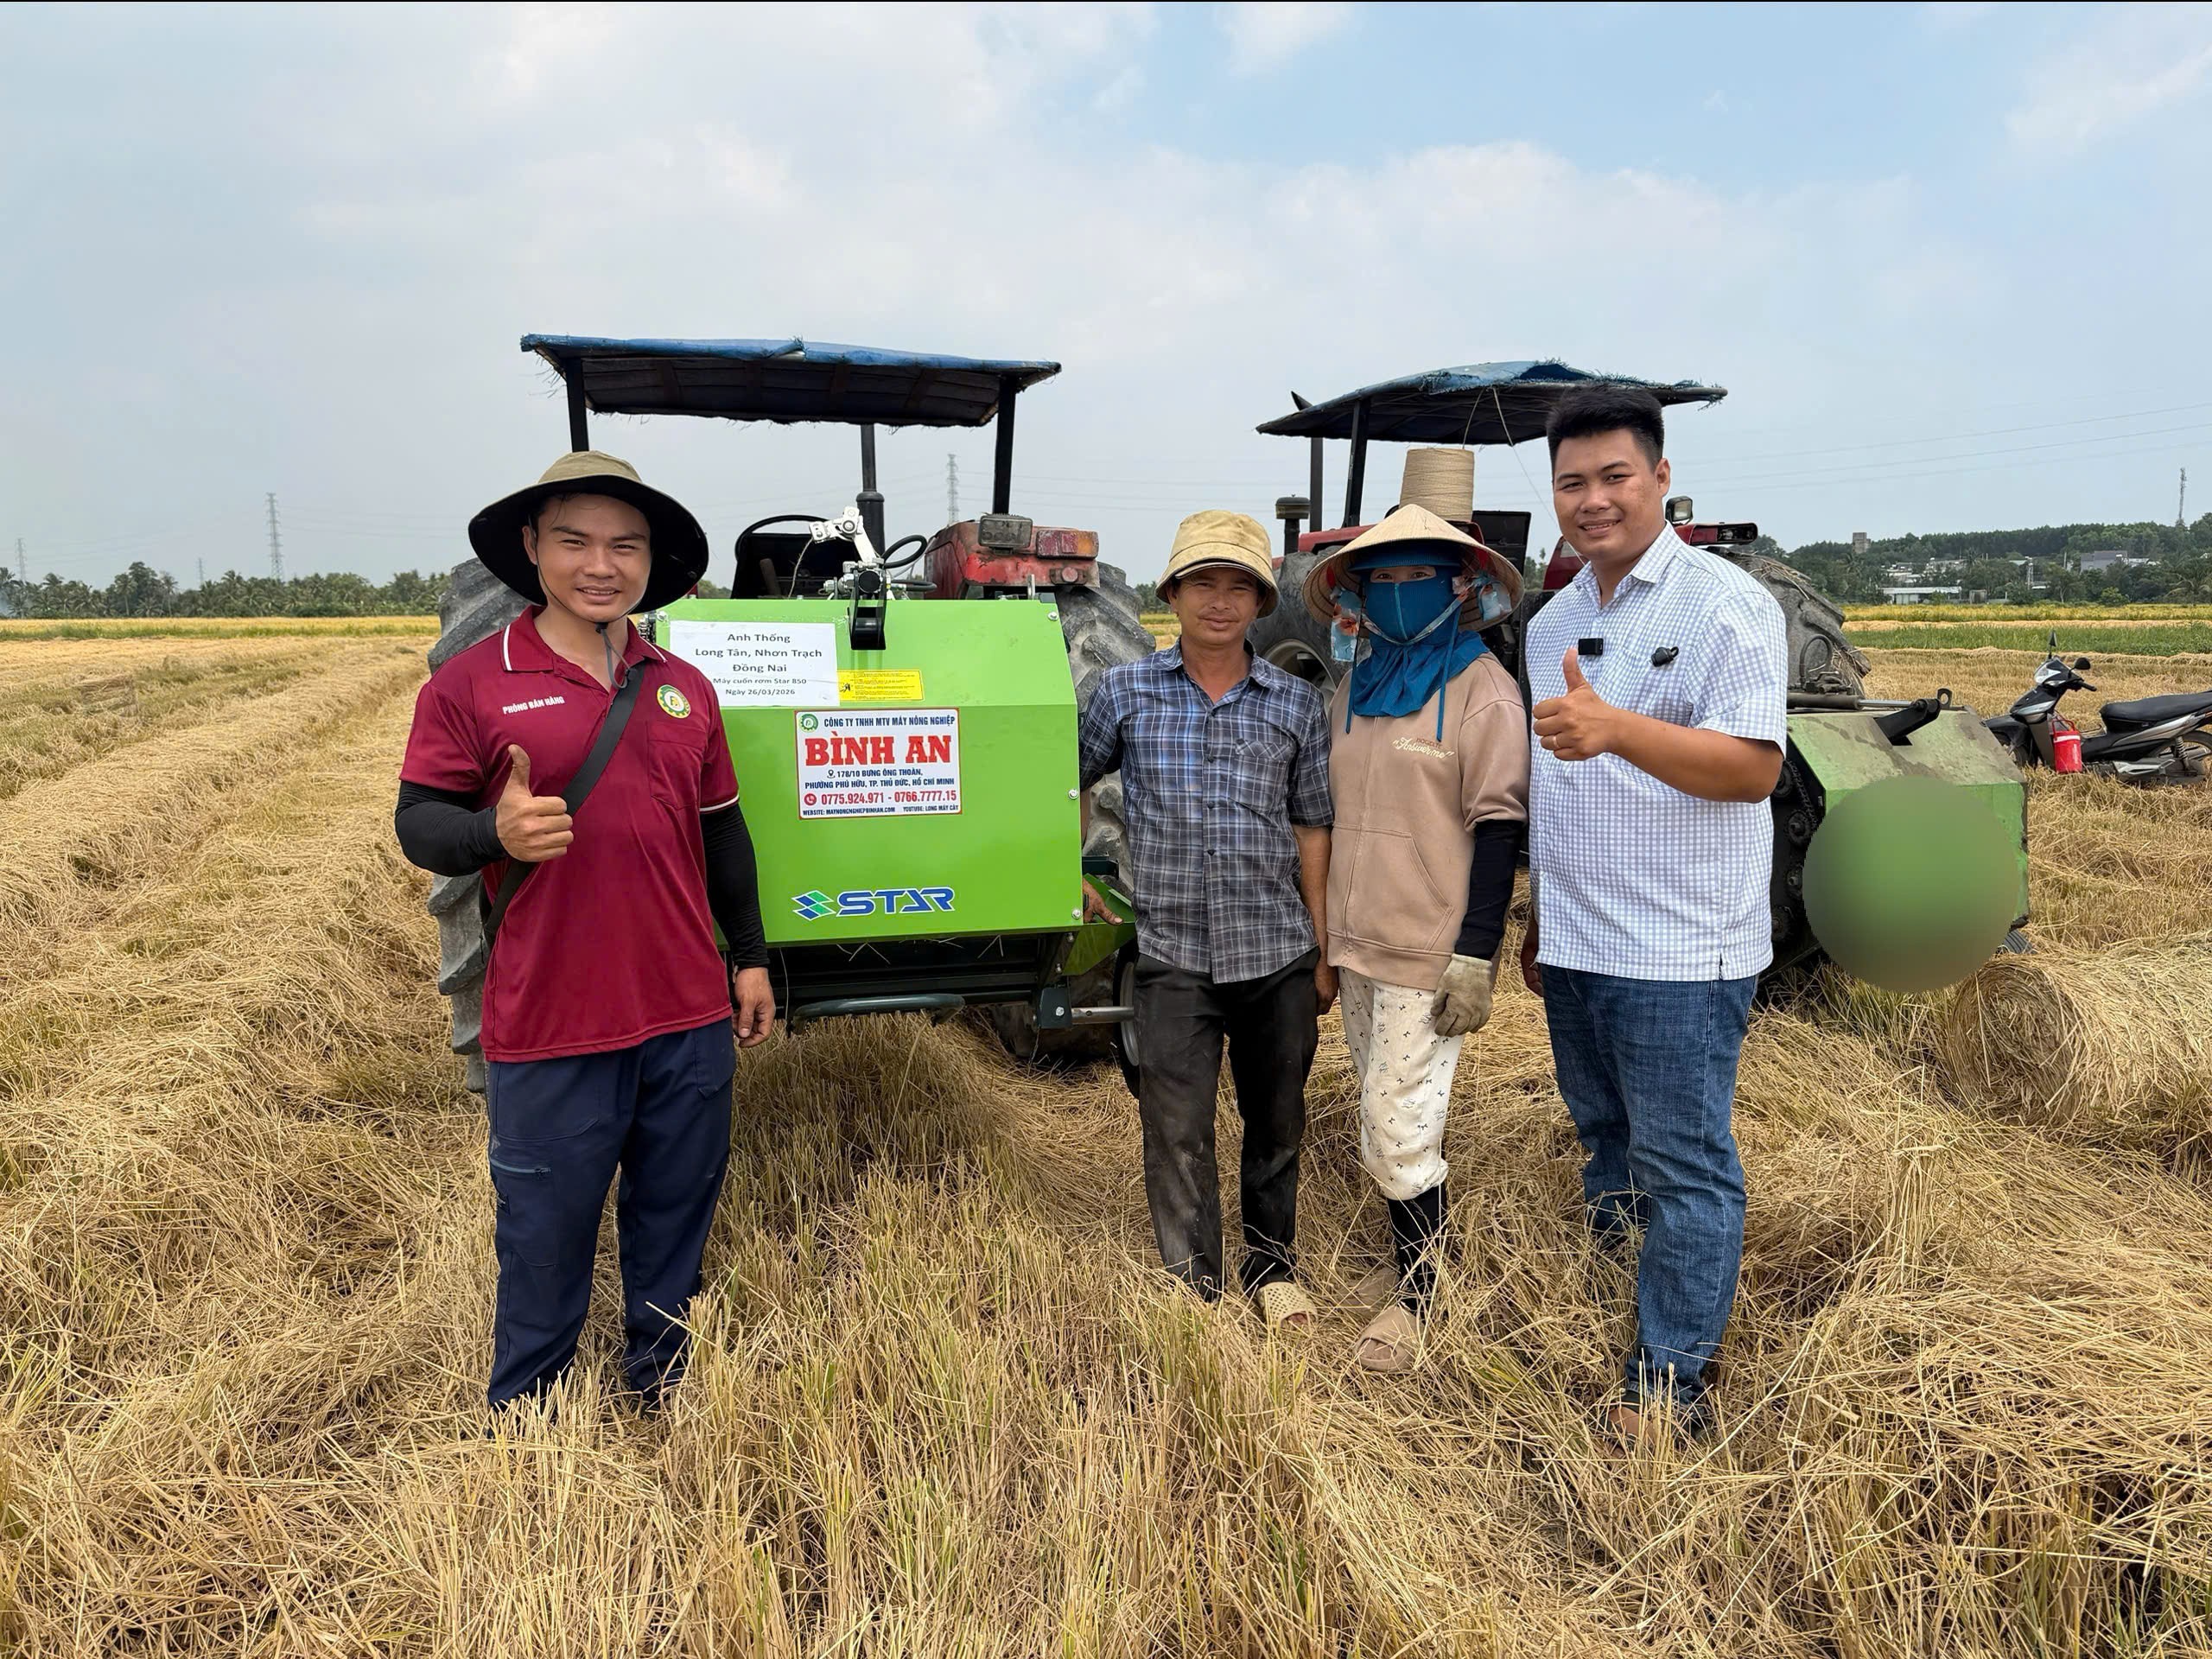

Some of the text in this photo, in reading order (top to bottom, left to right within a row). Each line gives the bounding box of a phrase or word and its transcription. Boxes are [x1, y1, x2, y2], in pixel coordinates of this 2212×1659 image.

[754, 633, 791, 644] Thống
[695, 649, 723, 658] Long
[727, 649, 751, 658] Tân,
[791, 649, 823, 659] Trạch
[733, 664, 787, 673] Đồng Nai
[502, 696, 565, 715] PHÒNG BÁN HÀNG
[823, 716, 843, 728] CÔNG
[845, 718, 854, 727] TY
[855, 717, 874, 727] TNHH
[875, 717, 890, 726] MTV
[892, 715, 907, 726] MÁY
[909, 715, 928, 726] NÔNG
[930, 714, 956, 727] NGHIỆP
[804, 730, 951, 766] BÌNH AN
[882, 768, 897, 777] ÔNG
[804, 779, 834, 790] PHƯỜNG
[880, 778, 893, 787] THỦ
[923, 777, 935, 785] CHÍ
[821, 791, 884, 805] 0775.924.971
[894, 790, 957, 803] 0766.7777.15
[836, 886, 956, 918] STAR
